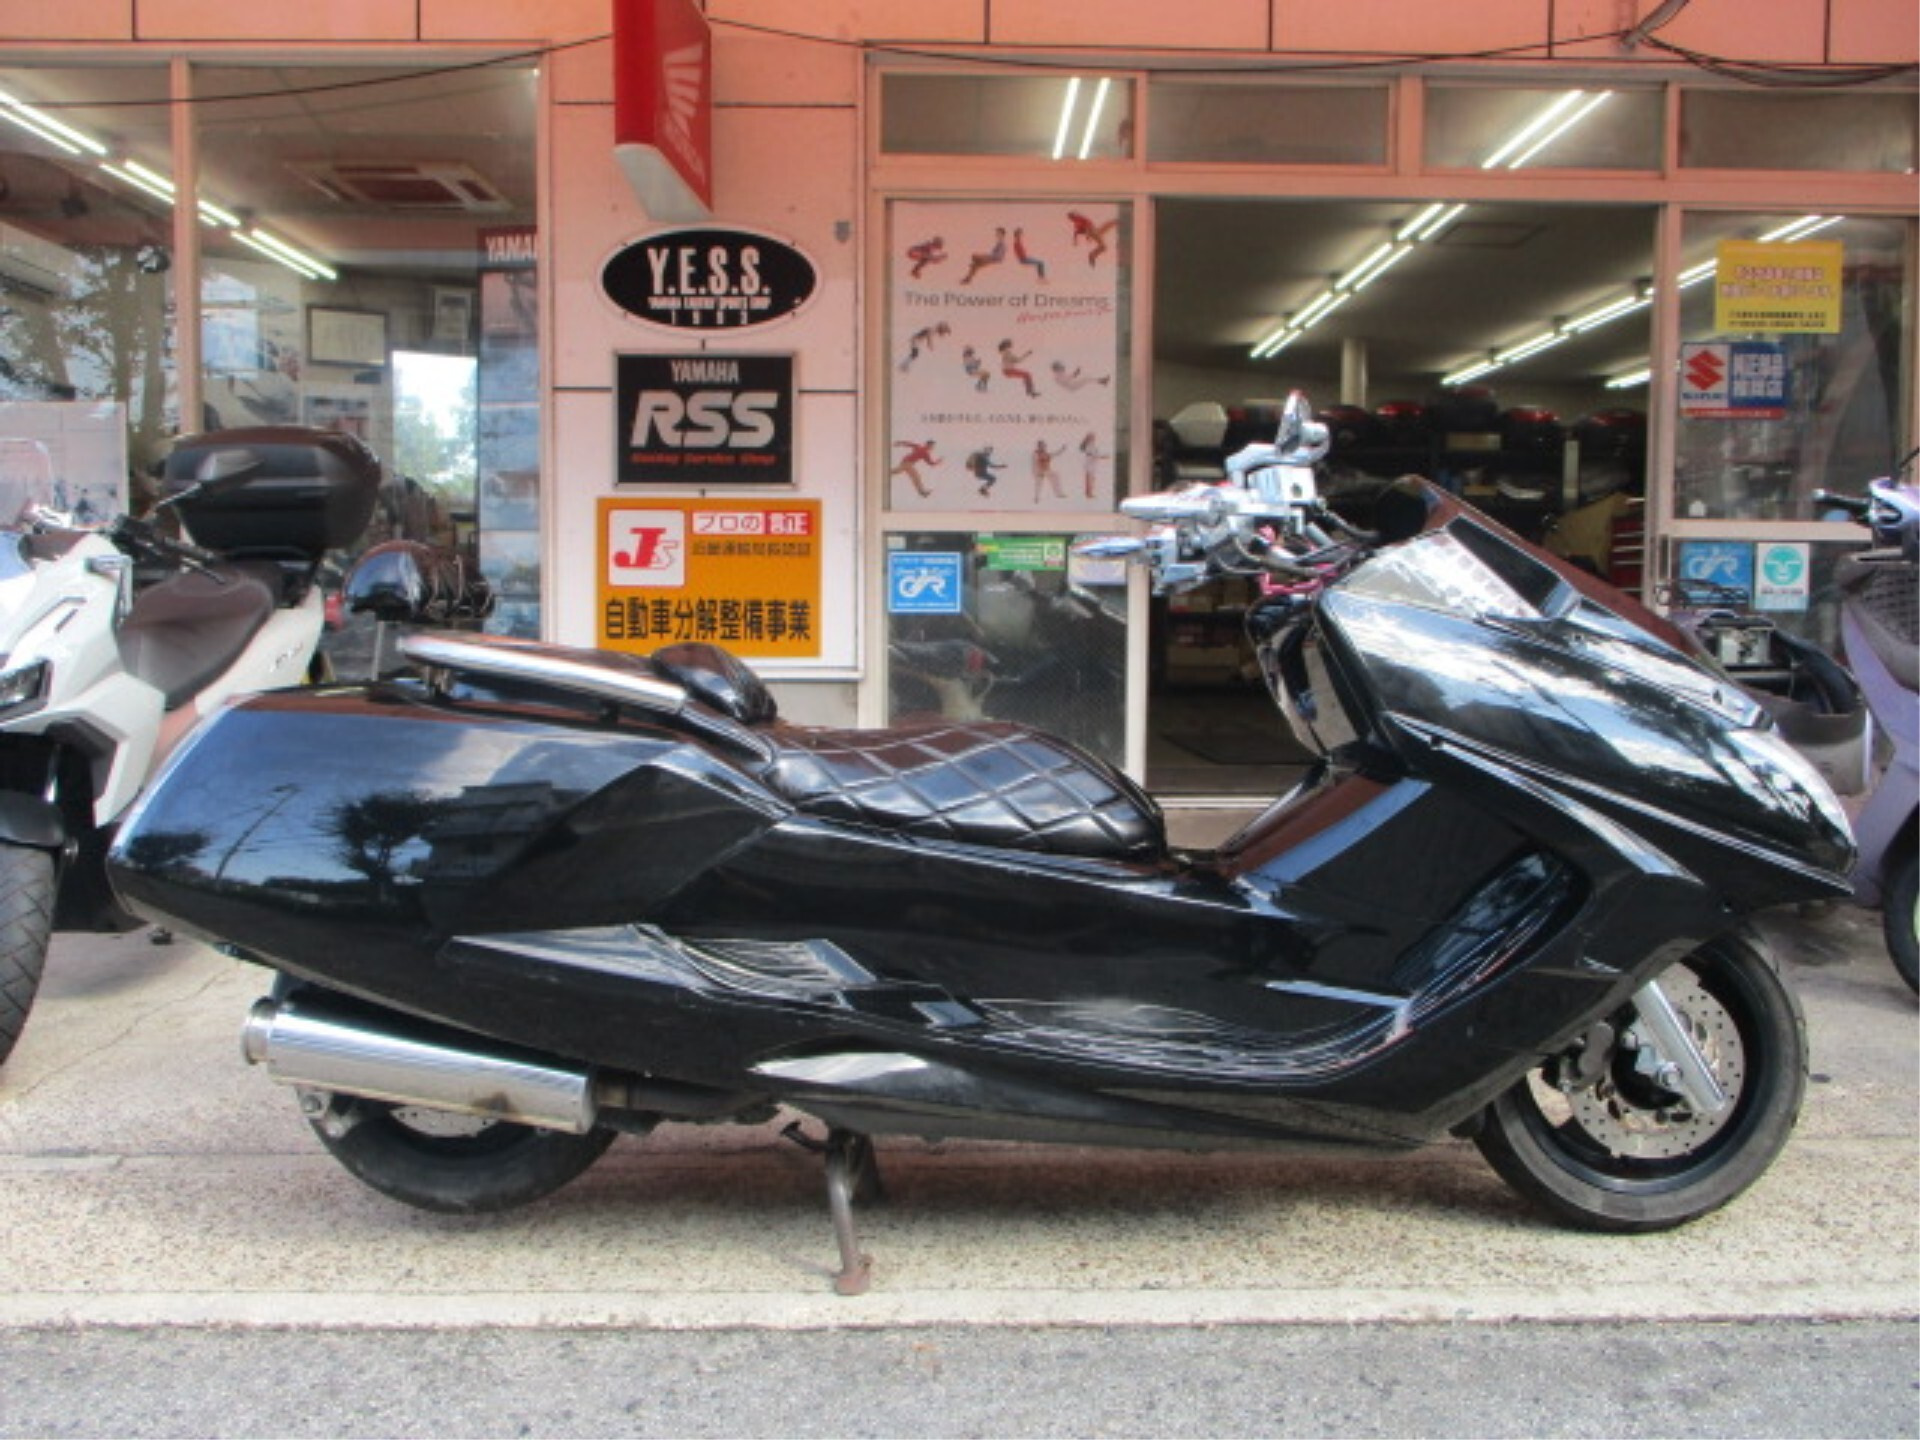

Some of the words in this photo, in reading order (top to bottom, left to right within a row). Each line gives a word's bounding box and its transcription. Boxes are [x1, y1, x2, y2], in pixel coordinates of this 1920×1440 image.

[646, 245, 772, 296] Y.E.S.S.
[905, 290, 940, 306] The
[944, 292, 1003, 307] Power
[1008, 293, 1030, 307] of
[1034, 293, 1109, 308] Dreams
[670, 359, 740, 384] YAMAHA
[630, 390, 778, 449] RSS
[605, 597, 812, 643] 自動車分解整備事業
